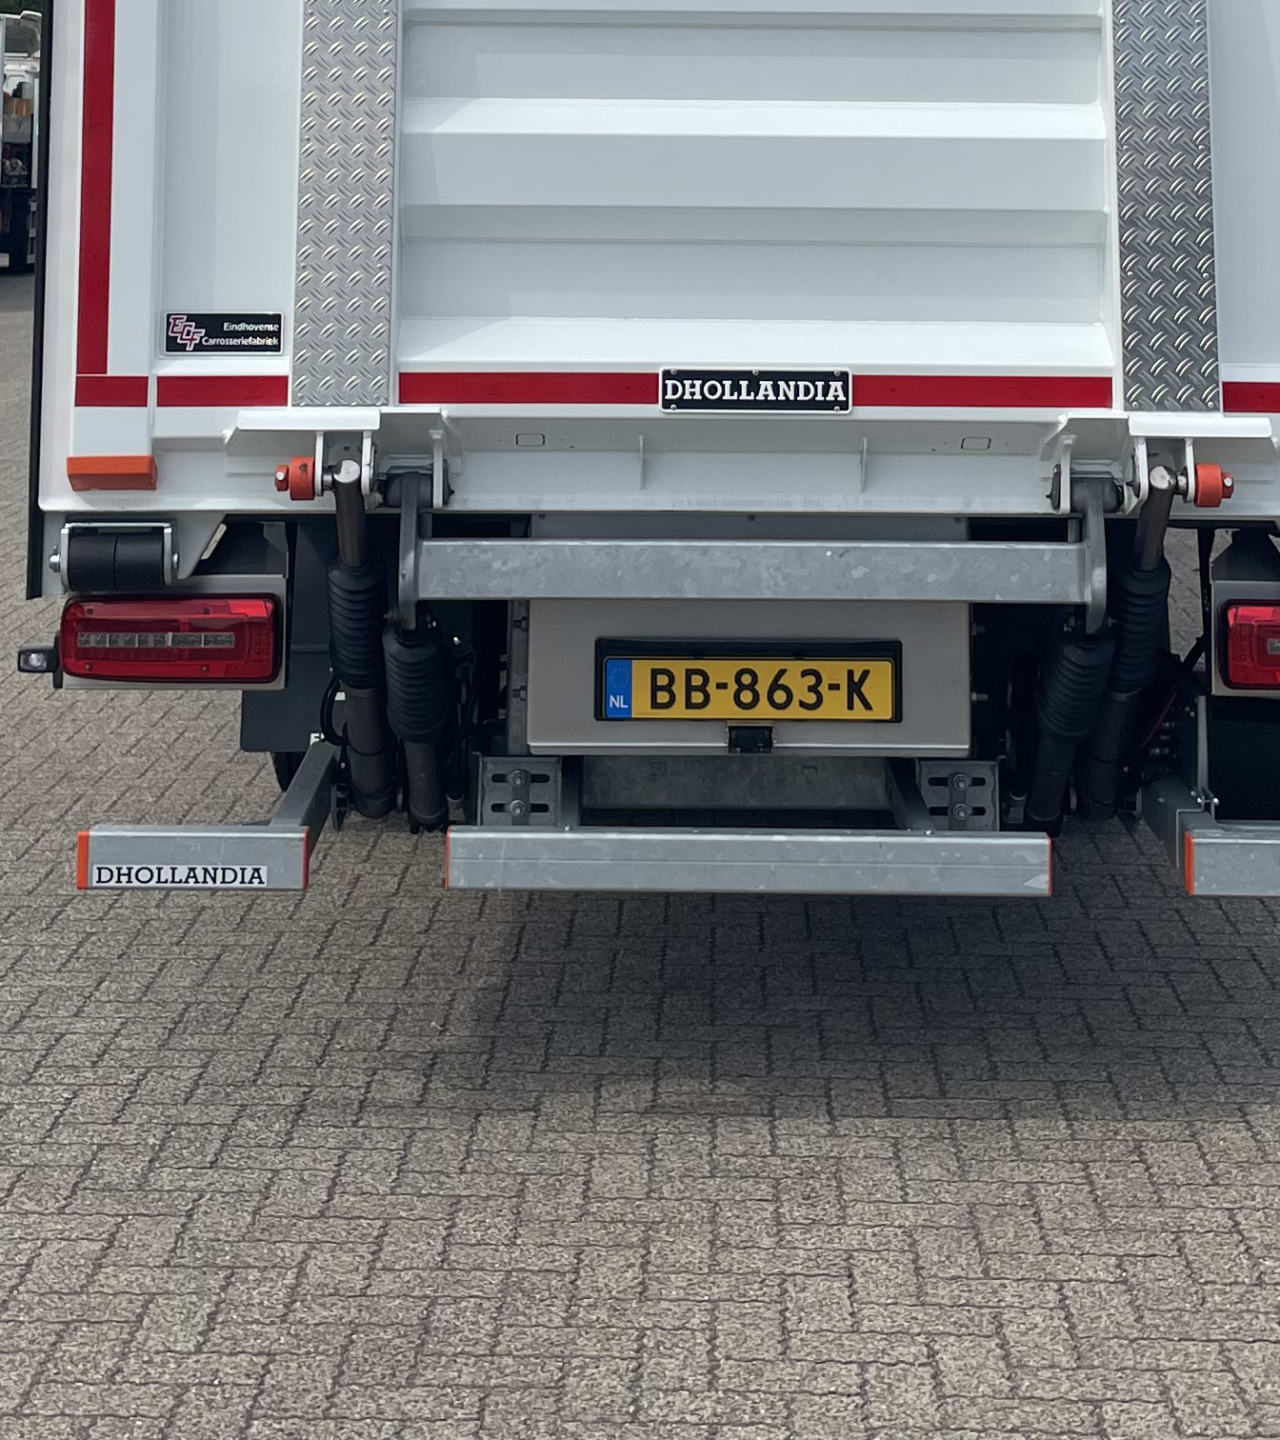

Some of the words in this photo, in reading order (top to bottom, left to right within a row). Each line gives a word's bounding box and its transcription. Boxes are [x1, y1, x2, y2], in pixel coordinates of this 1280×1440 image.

[223, 322, 279, 332] Eindhovense
[202, 337, 279, 347] Carrosseriefabriek
[664, 379, 847, 402] DHOLLANDIA
[609, 694, 629, 709] NL
[649, 667, 874, 711] BB-863-K
[95, 866, 265, 885] DHOLLANDIA
